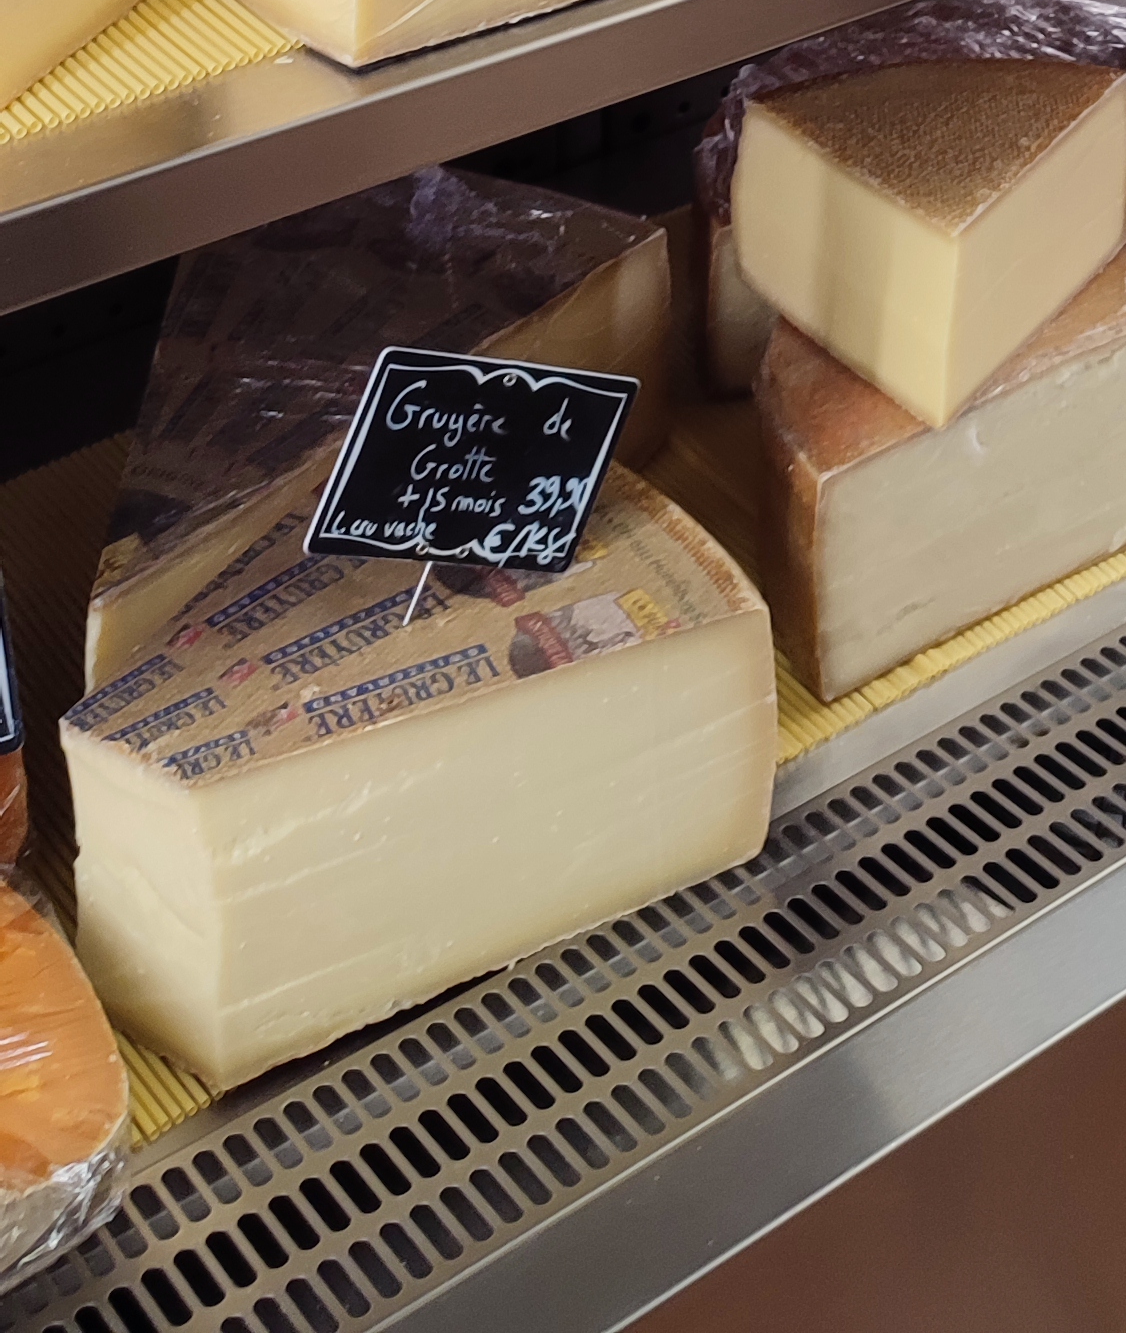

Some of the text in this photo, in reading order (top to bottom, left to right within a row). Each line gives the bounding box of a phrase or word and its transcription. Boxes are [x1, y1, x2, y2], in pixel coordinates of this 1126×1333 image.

[385, 380, 571, 447] Gruyère de
[410, 443, 497, 482] Grotte
[451, 490, 506, 516] mois
[459, 655, 500, 686] LE
